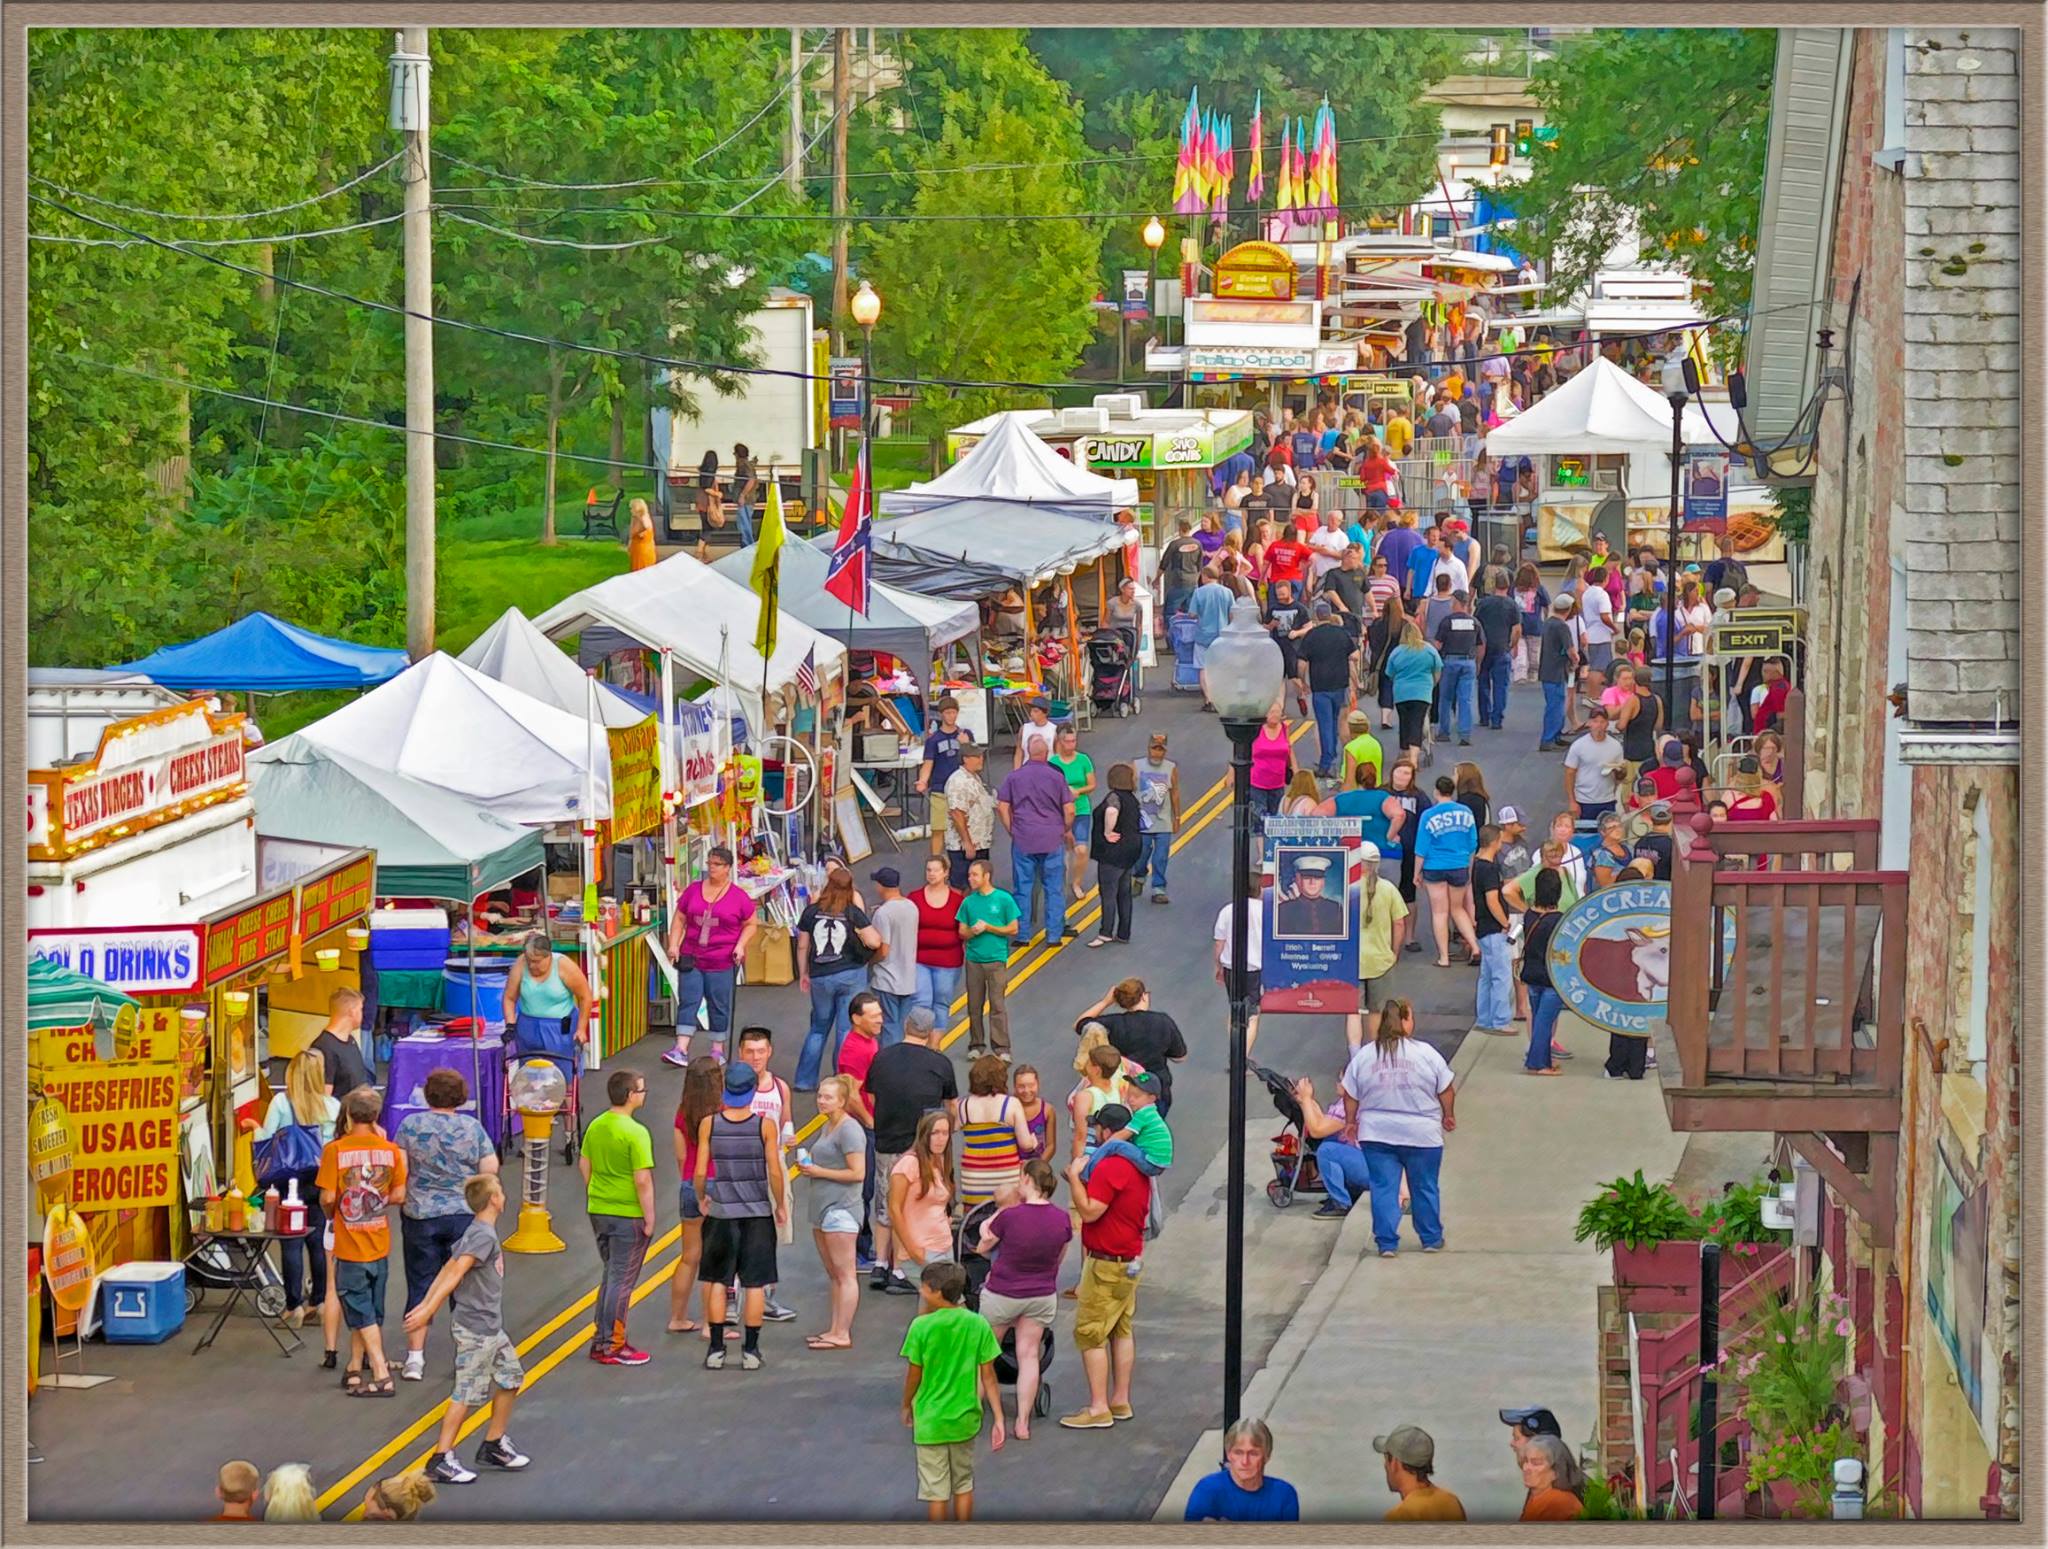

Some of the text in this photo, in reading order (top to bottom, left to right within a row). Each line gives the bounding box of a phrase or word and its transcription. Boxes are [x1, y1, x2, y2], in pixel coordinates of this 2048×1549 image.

[1087, 440, 1145, 462] CANDY
[1171, 437, 1198, 450] SNO
[1730, 634, 1768, 645] EXIT
[66, 783, 99, 832] TEXAS
[100, 769, 145, 819] BURGERS
[169, 749, 207, 795] CHEESE
[207, 738, 241, 784] STEAKS
[1560, 906, 1600, 943] The
[104, 940, 191, 982] DRINKS
[153, 1012, 168, 1032] &
[65, 1038, 152, 1063] CHSE
